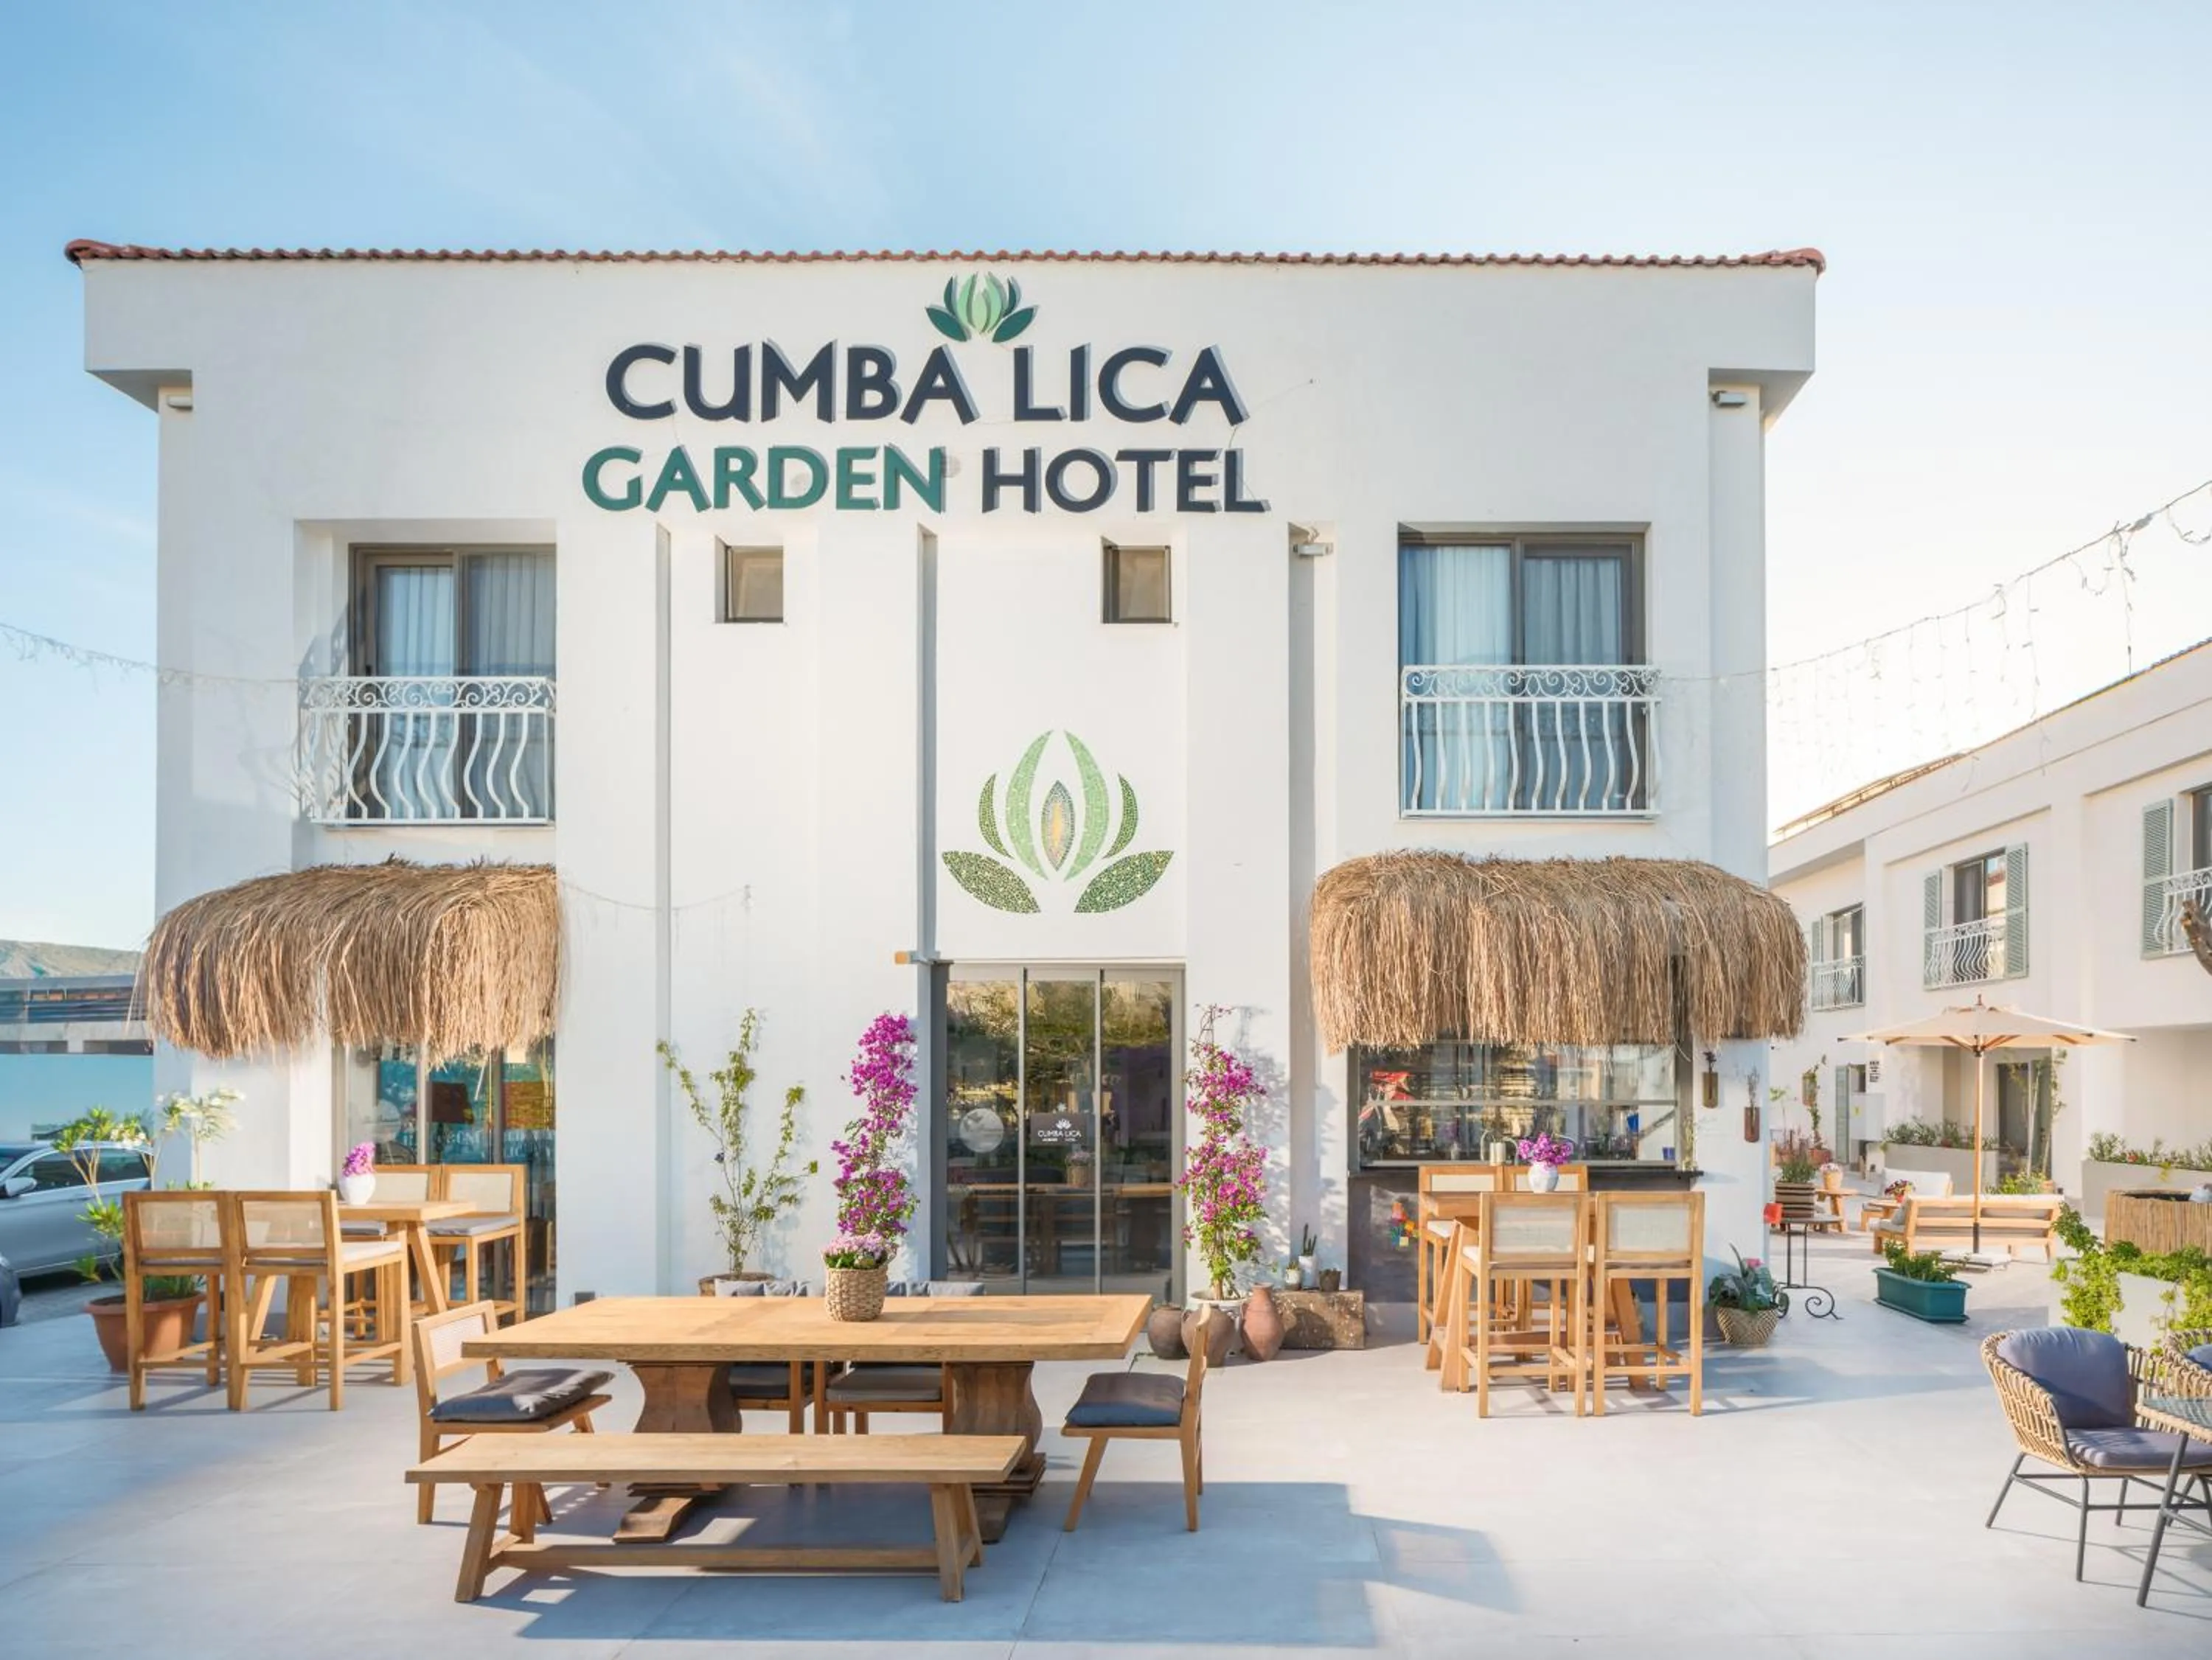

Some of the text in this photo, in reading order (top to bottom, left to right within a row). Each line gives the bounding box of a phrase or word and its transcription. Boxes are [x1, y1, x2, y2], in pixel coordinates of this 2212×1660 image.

[605, 338, 1250, 427] CUMBA LICA
[582, 444, 1271, 515] GARDEN HOTEL
